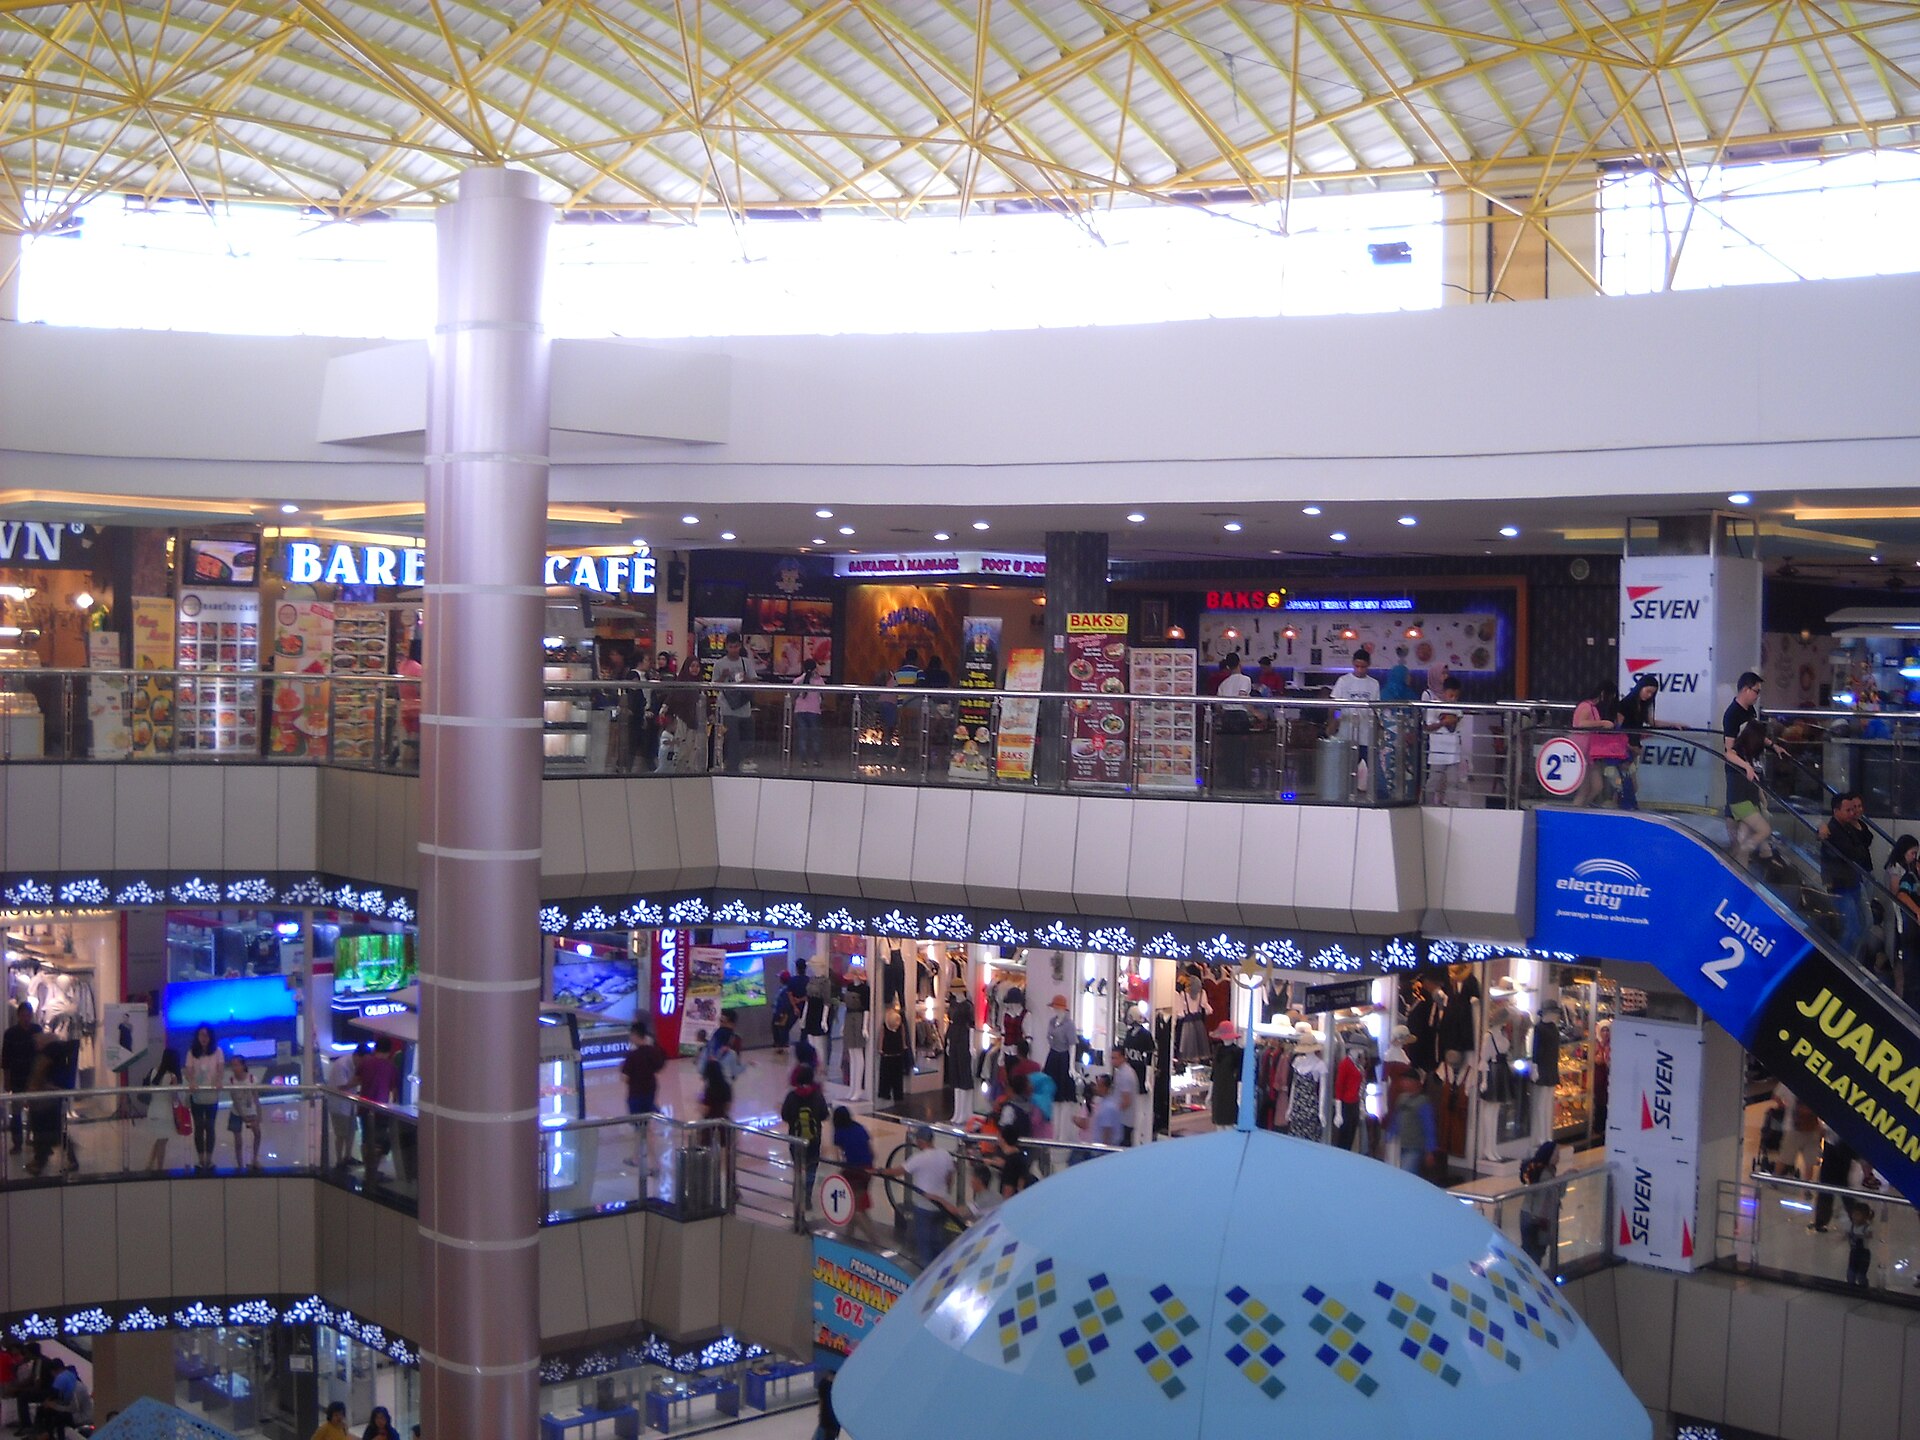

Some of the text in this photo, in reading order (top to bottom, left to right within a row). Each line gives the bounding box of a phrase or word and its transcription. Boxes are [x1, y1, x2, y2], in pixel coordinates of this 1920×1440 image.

[291, 543, 656, 594] BARE CAFÉ
[1024, 561, 1047, 574] BOD
[1630, 600, 1700, 619] SEVEN
[1630, 673, 1699, 693] SVEN
[1546, 753, 1577, 781] 2nd
[1641, 746, 1697, 766] EVEN
[1556, 877, 1651, 898] electronic
[1584, 893, 1621, 910] city
[1714, 898, 1777, 958] Lantai
[750, 939, 787, 951] SHARP
[661, 928, 676, 1014] SHAR
[1700, 936, 1746, 990] 2
[1796, 987, 1920, 1116] JUARA
[285, 1076, 299, 1086] LG
[1654, 1050, 1674, 1129] SEVEN
[1790, 1037, 1920, 1162] PELAYANAN
[831, 1188, 846, 1213] 1st
[1632, 1166, 1652, 1245] SEVEN
[834, 1295, 865, 1328] 10%
